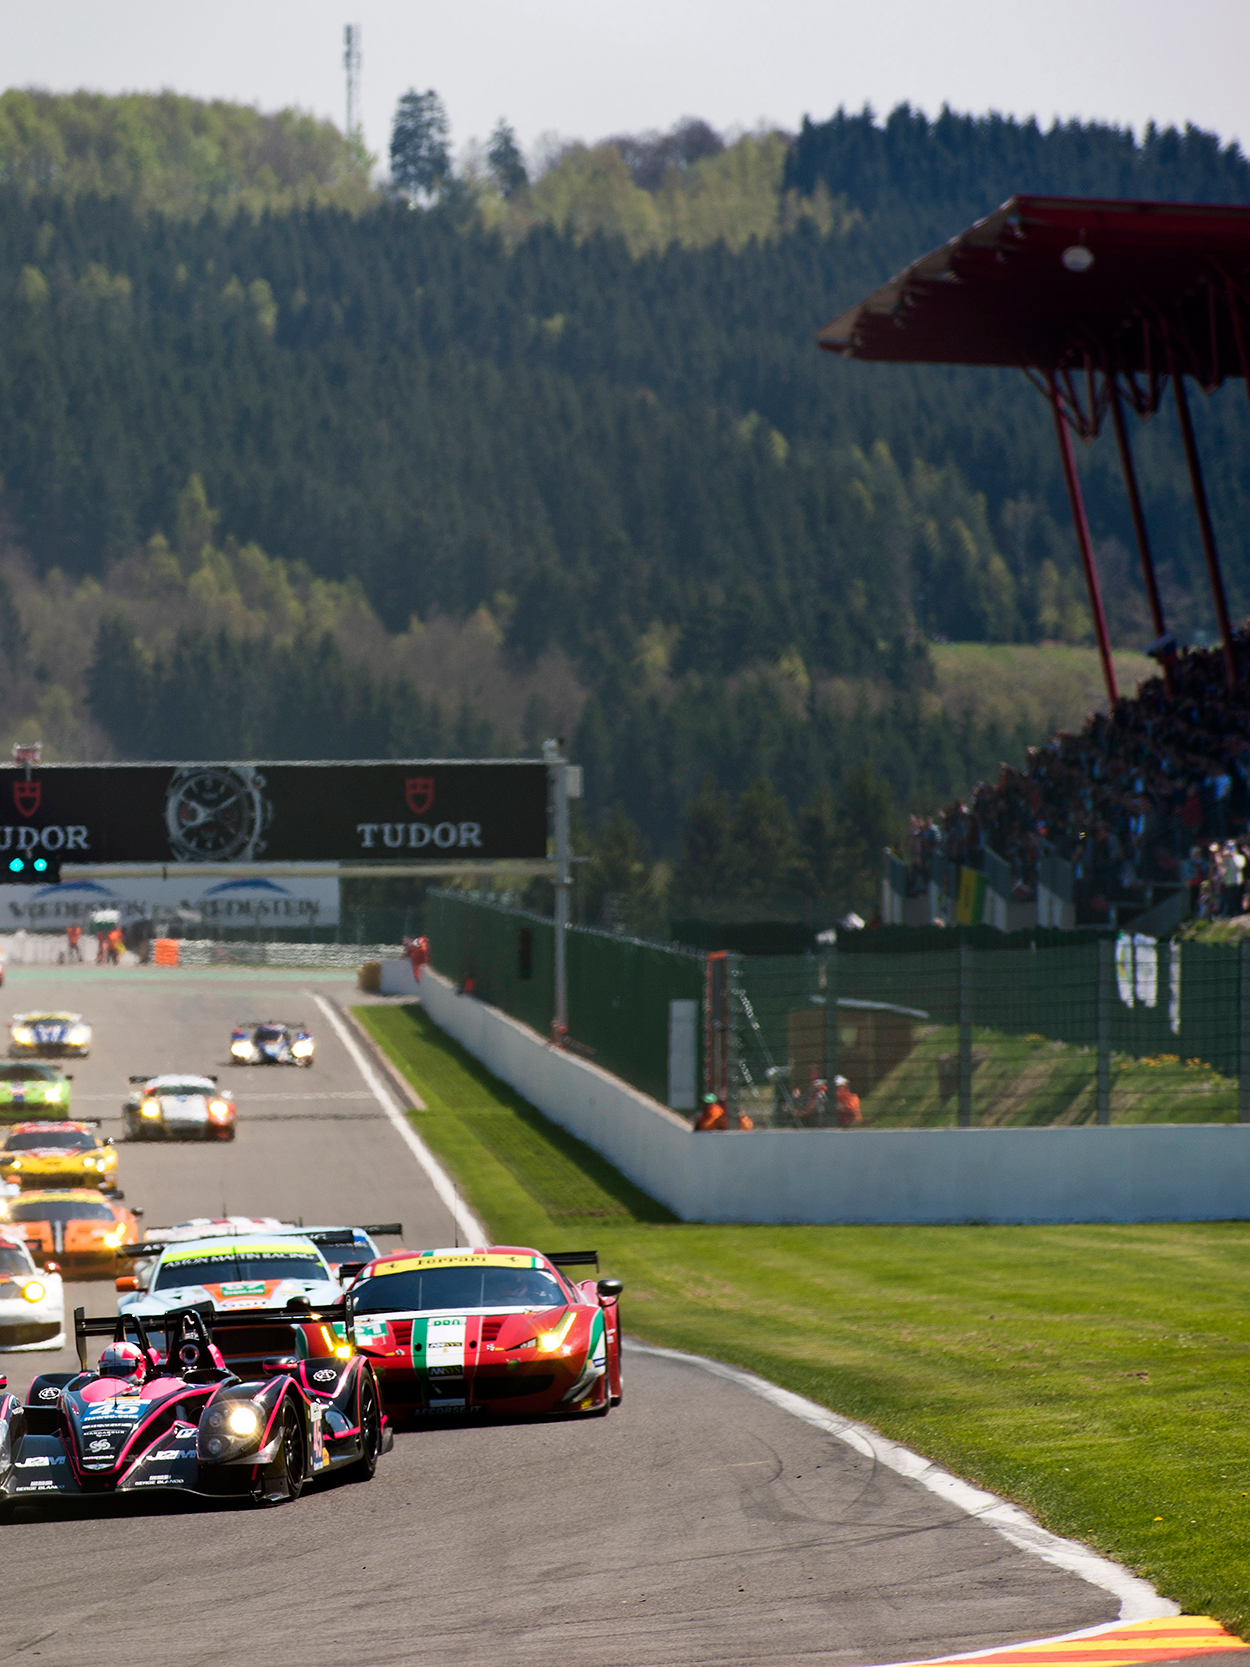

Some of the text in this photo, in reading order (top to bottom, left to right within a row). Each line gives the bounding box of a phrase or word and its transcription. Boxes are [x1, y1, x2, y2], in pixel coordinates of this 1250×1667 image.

[357, 822, 484, 849] TUDOR
[208, 1252, 261, 1263] MARTIN
[265, 1251, 315, 1261] RACING
[89, 1403, 140, 1415] 45
